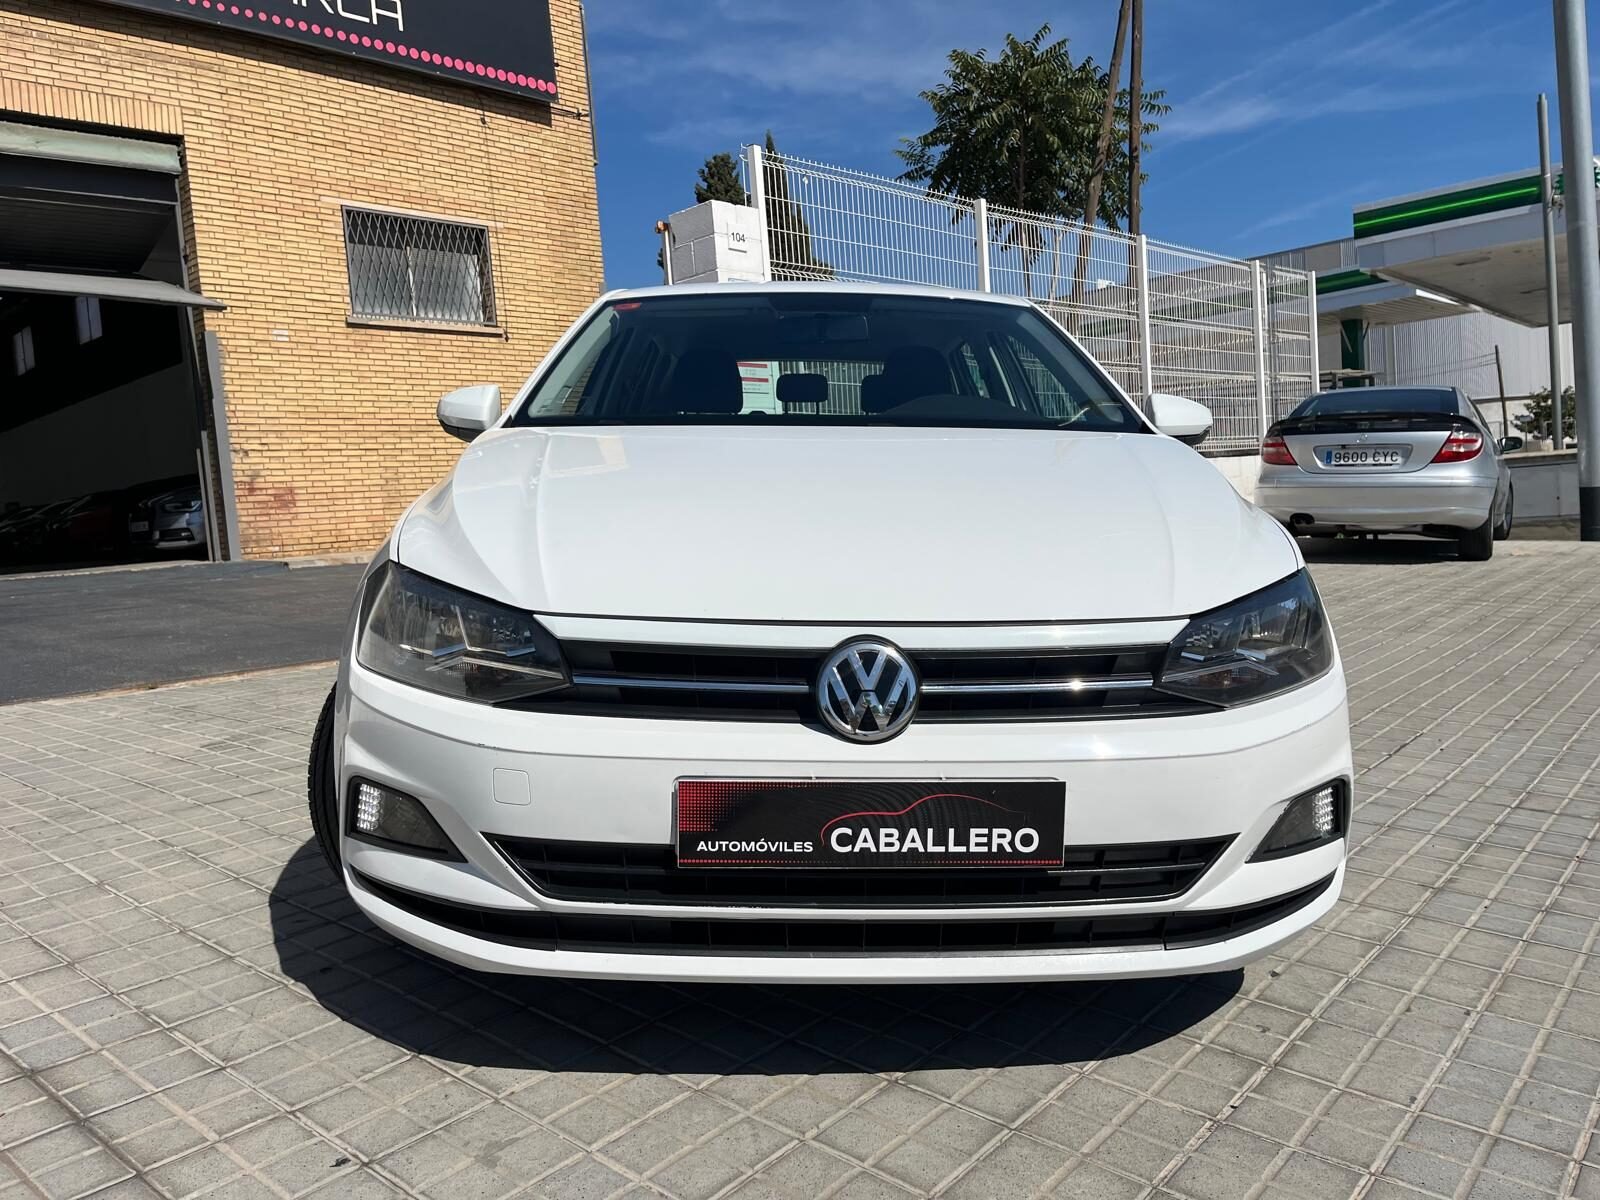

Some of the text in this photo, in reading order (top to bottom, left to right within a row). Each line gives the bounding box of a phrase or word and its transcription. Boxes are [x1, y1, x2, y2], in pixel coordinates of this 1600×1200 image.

[731, 231, 746, 243] 104
[1334, 451, 1368, 463] 9600
[1372, 450, 1399, 462] CYC
[696, 827, 1040, 853] AUTOMÓVILES CABALLERO
